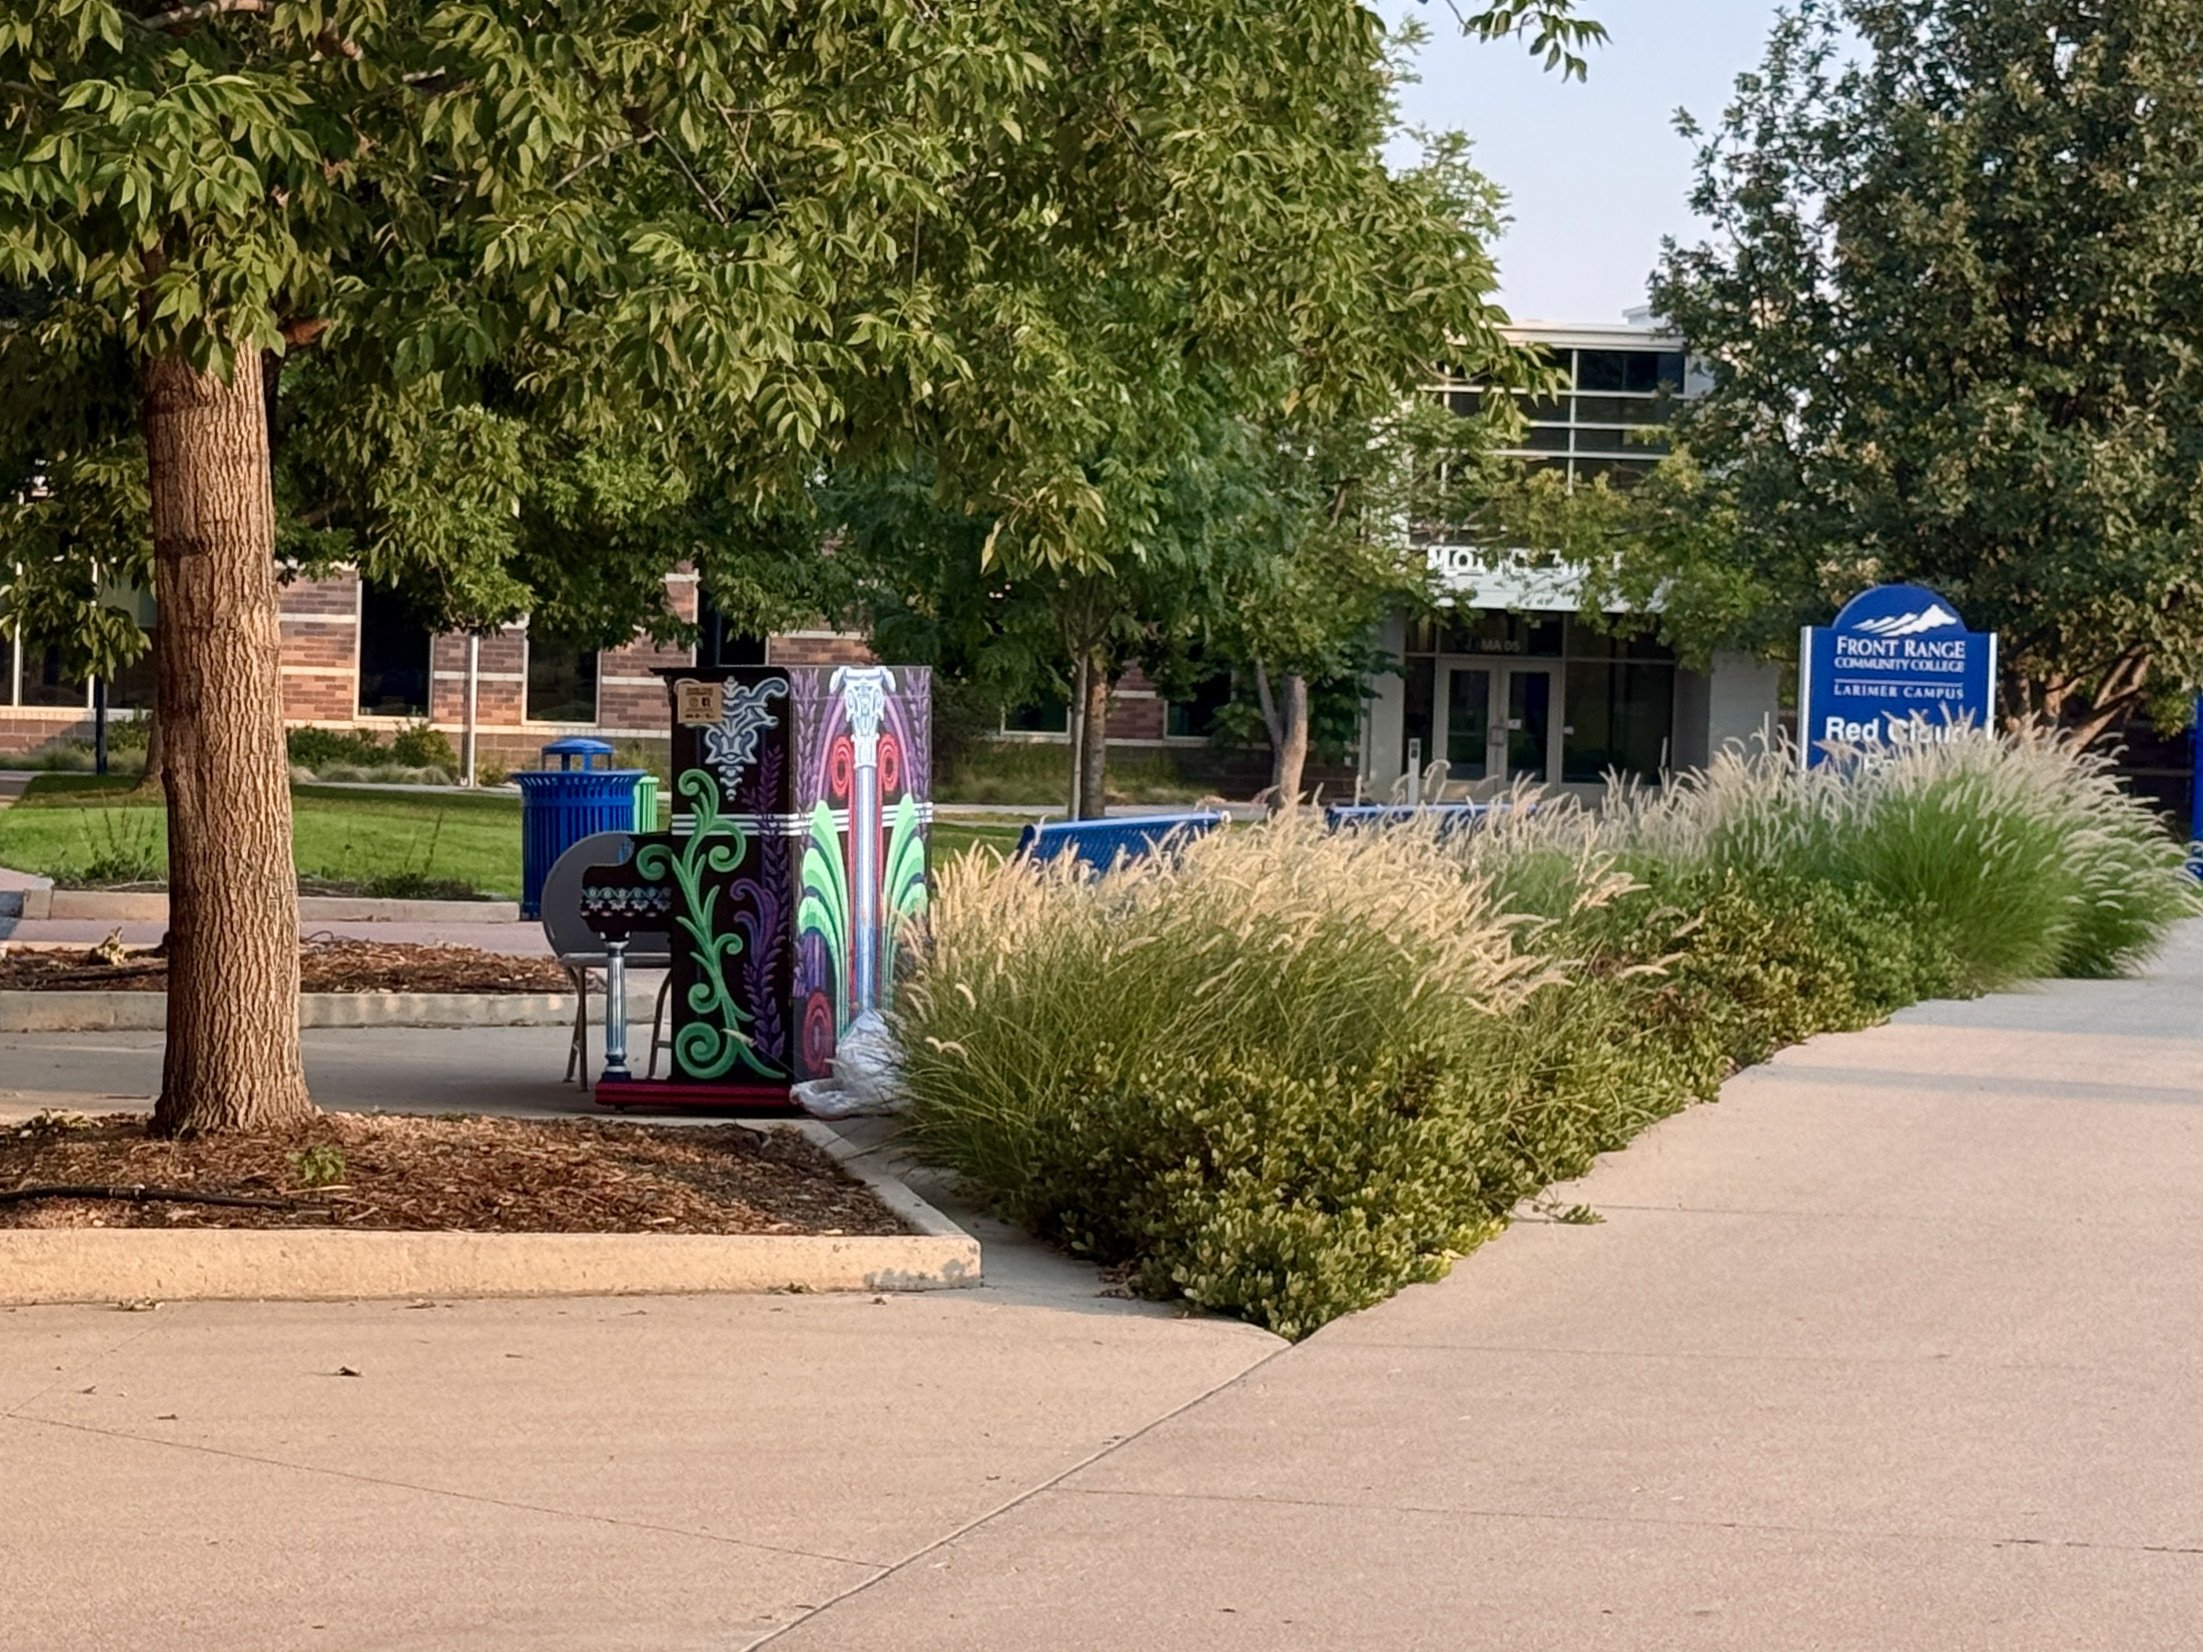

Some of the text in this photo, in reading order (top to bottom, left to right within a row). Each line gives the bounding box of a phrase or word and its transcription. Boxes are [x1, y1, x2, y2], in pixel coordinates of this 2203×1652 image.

[1836, 636, 1966, 660] FRONT RANGE
[1834, 657, 1966, 673] COMMUNITY COLLEGE
[1834, 685, 1964, 700] LARIMER CAMPUS
[1825, 716, 1880, 743] Red
